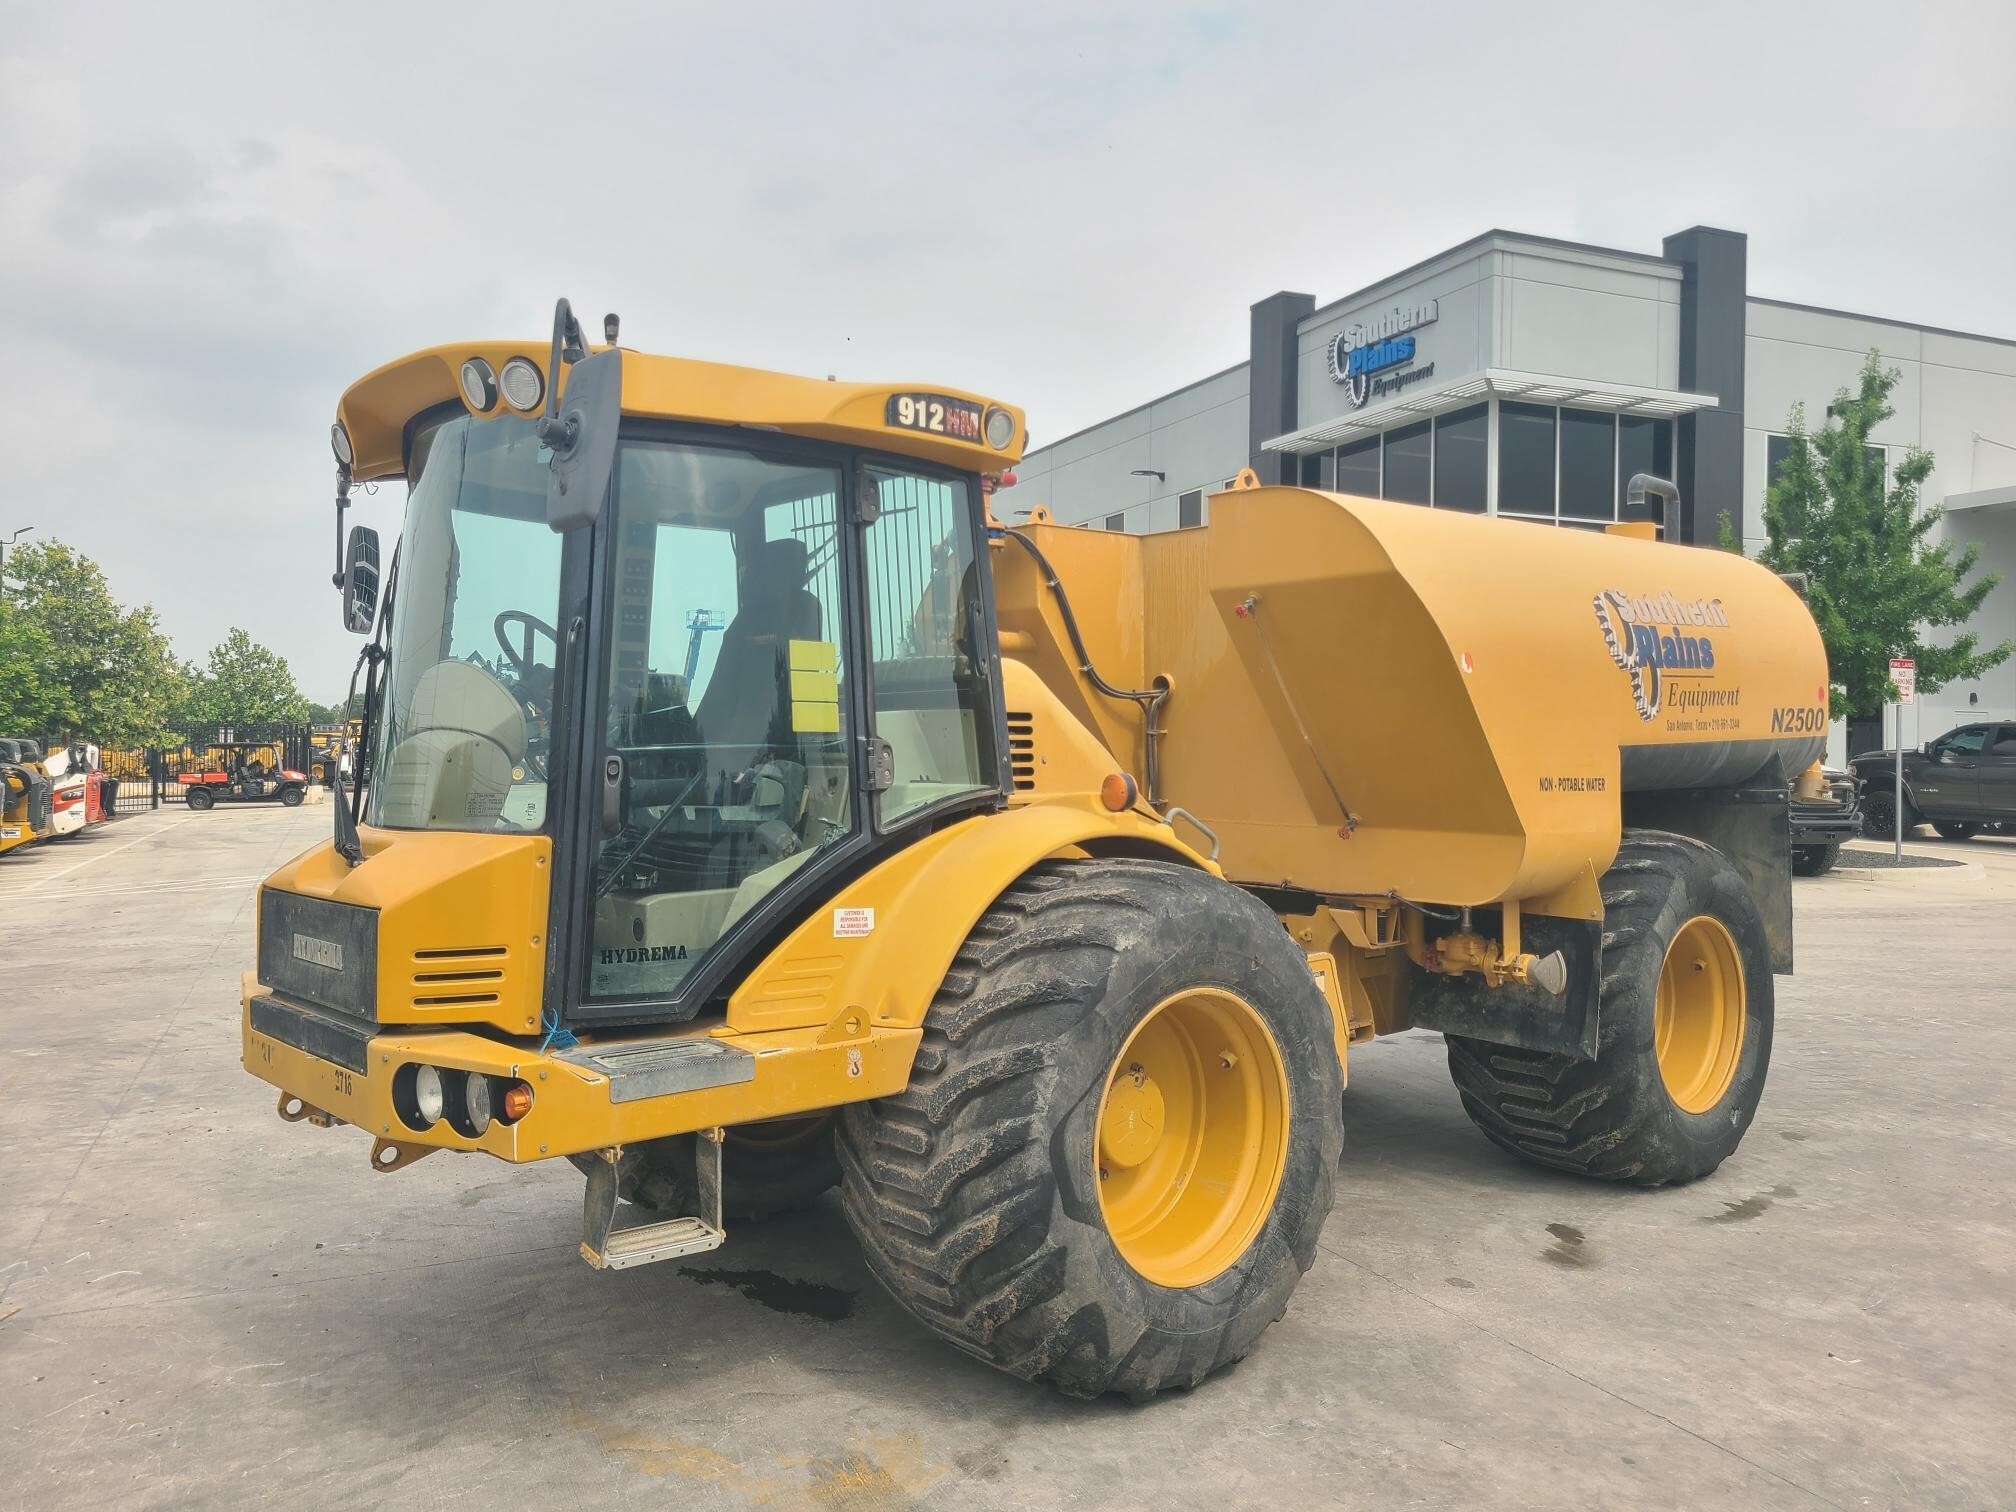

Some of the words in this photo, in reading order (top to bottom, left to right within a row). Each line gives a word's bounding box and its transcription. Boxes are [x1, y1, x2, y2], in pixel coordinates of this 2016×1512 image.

[1343, 299, 1439, 353] Southern
[1349, 336, 1416, 377] Plains
[1371, 362, 1435, 397] Equipment
[1612, 589, 1729, 628] Southern
[1631, 624, 1715, 669] Plains
[1667, 682, 1740, 714] Equipment
[1666, 719, 1676, 732] San
[1771, 707, 1825, 733] N2500
[1539, 777, 1554, 793] NON
[1558, 777, 1585, 792] POTABLE
[1585, 777, 1606, 792] WATER
[601, 945, 688, 965] HYDREMA
